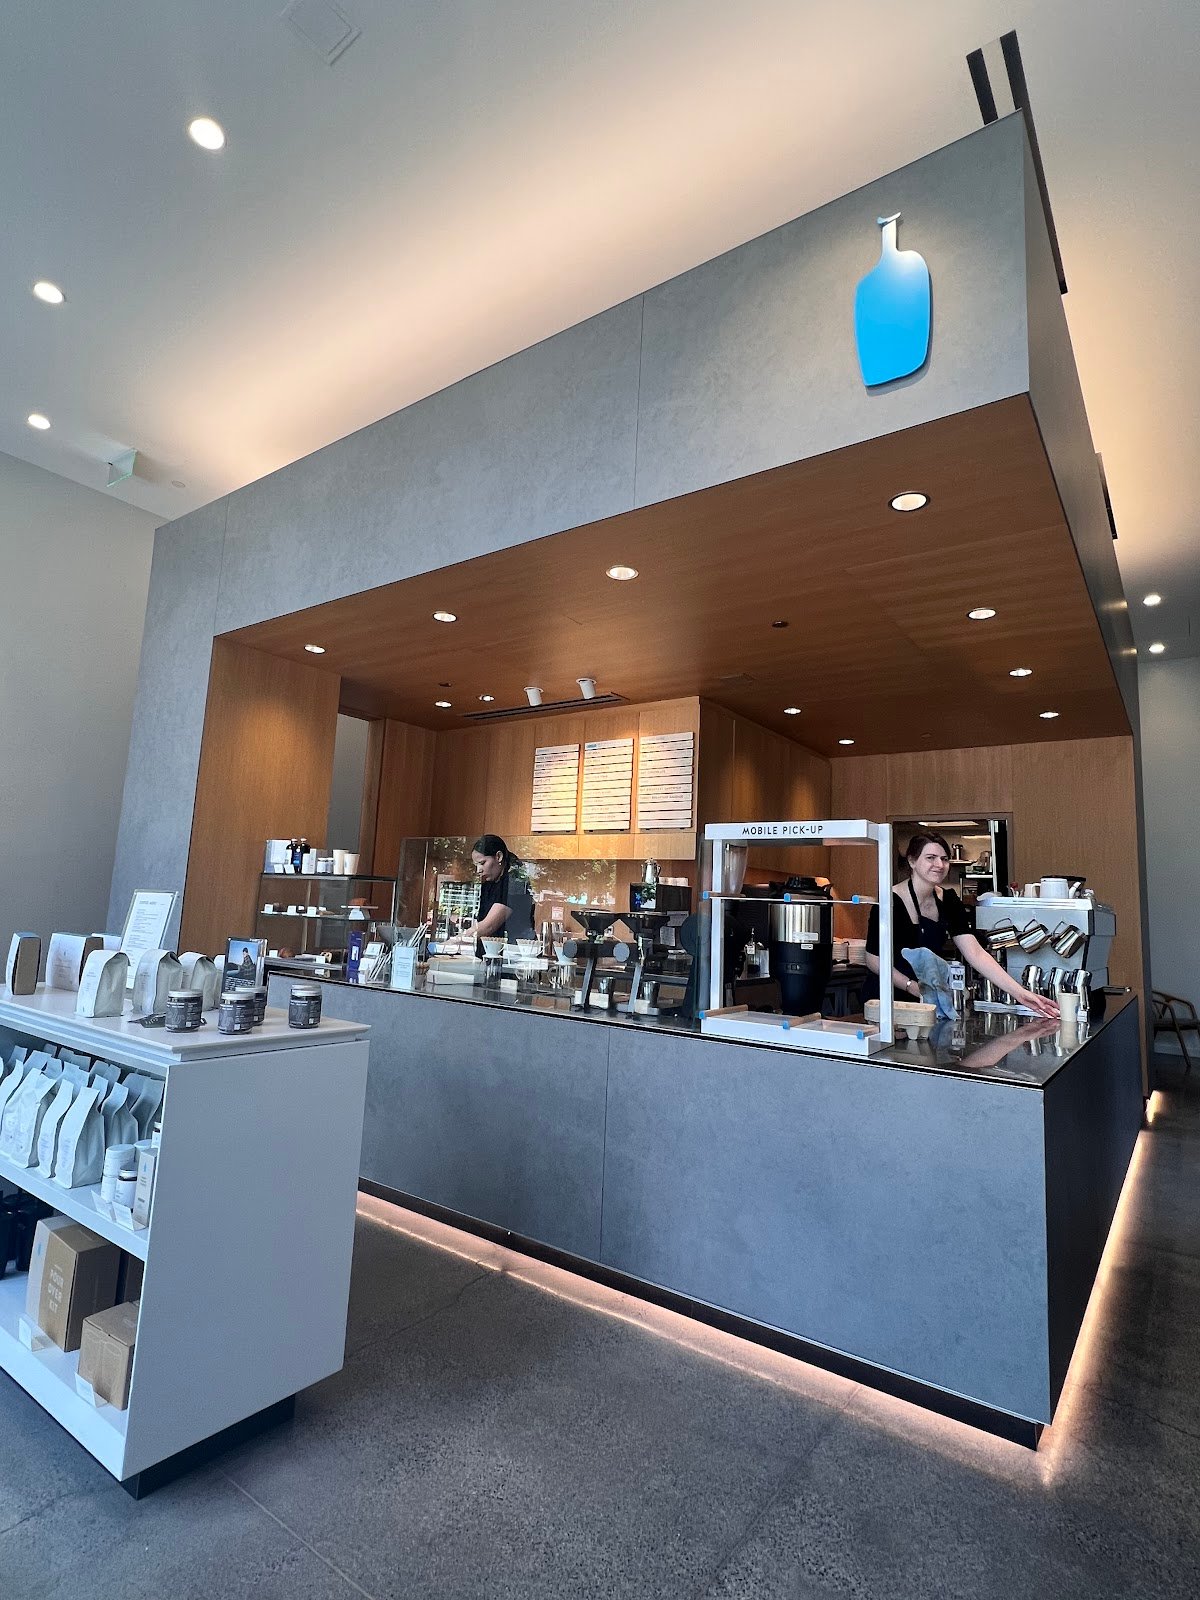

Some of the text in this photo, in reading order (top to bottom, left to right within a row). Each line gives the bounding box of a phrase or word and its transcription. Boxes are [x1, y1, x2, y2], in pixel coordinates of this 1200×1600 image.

[742, 825, 824, 835] MOBILE PICK-UP
[50, 1269, 64, 1288] POUR
[47, 1283, 62, 1303] OVER
[49, 1300, 58, 1313] KIT
